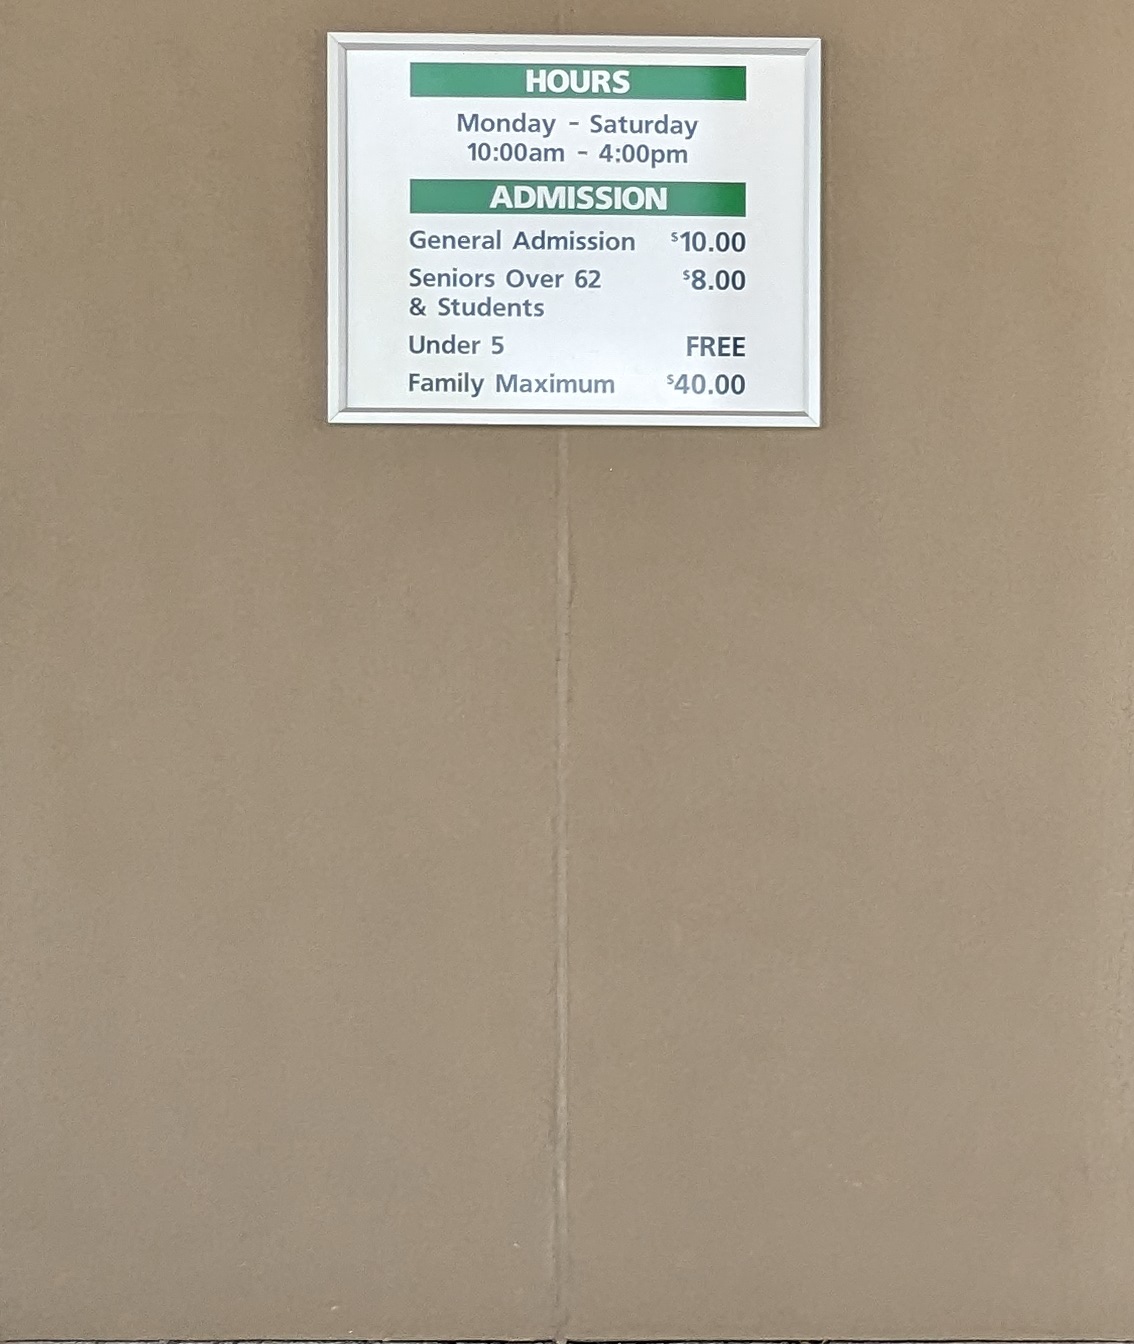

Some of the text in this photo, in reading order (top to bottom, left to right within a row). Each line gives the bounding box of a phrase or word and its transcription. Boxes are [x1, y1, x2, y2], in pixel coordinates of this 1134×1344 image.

[526, 69, 631, 94] HOURS
[457, 113, 557, 139] Monday
[590, 114, 698, 140] Saturday
[467, 142, 565, 162] 10:00am
[599, 143, 689, 169] 4:00pm
[489, 185, 668, 211] ADMISSION
[409, 229, 636, 252] General Admission
[670, 231, 746, 253] $10.00
[409, 267, 602, 289] Seniors Over 62
[682, 269, 746, 291] $8.00
[409, 296, 545, 318] & Students
[408, 334, 504, 355] Under 5
[686, 335, 746, 357] FREE
[408, 372, 615, 398] Family Maximum
[667, 373, 746, 396] $40.00
